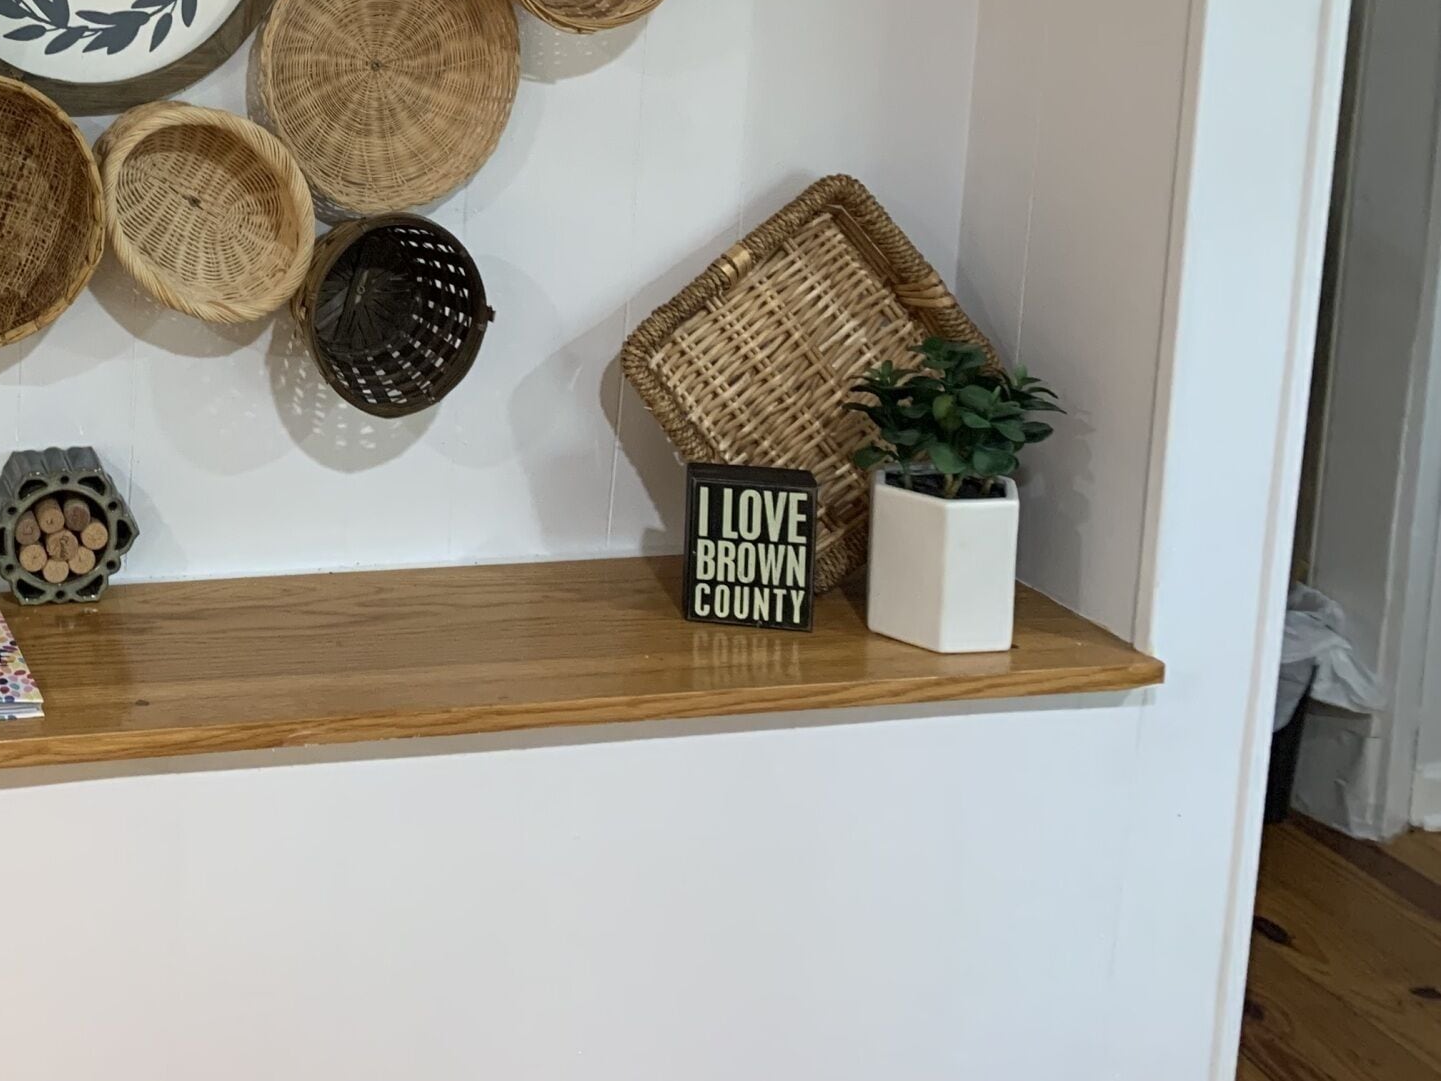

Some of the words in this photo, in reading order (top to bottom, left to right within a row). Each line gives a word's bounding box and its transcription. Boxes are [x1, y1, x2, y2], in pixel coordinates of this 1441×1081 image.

[698, 486, 709, 537] I
[722, 487, 808, 544] LOVE
[696, 538, 807, 588] BROWN
[694, 582, 806, 624] COUNTY
